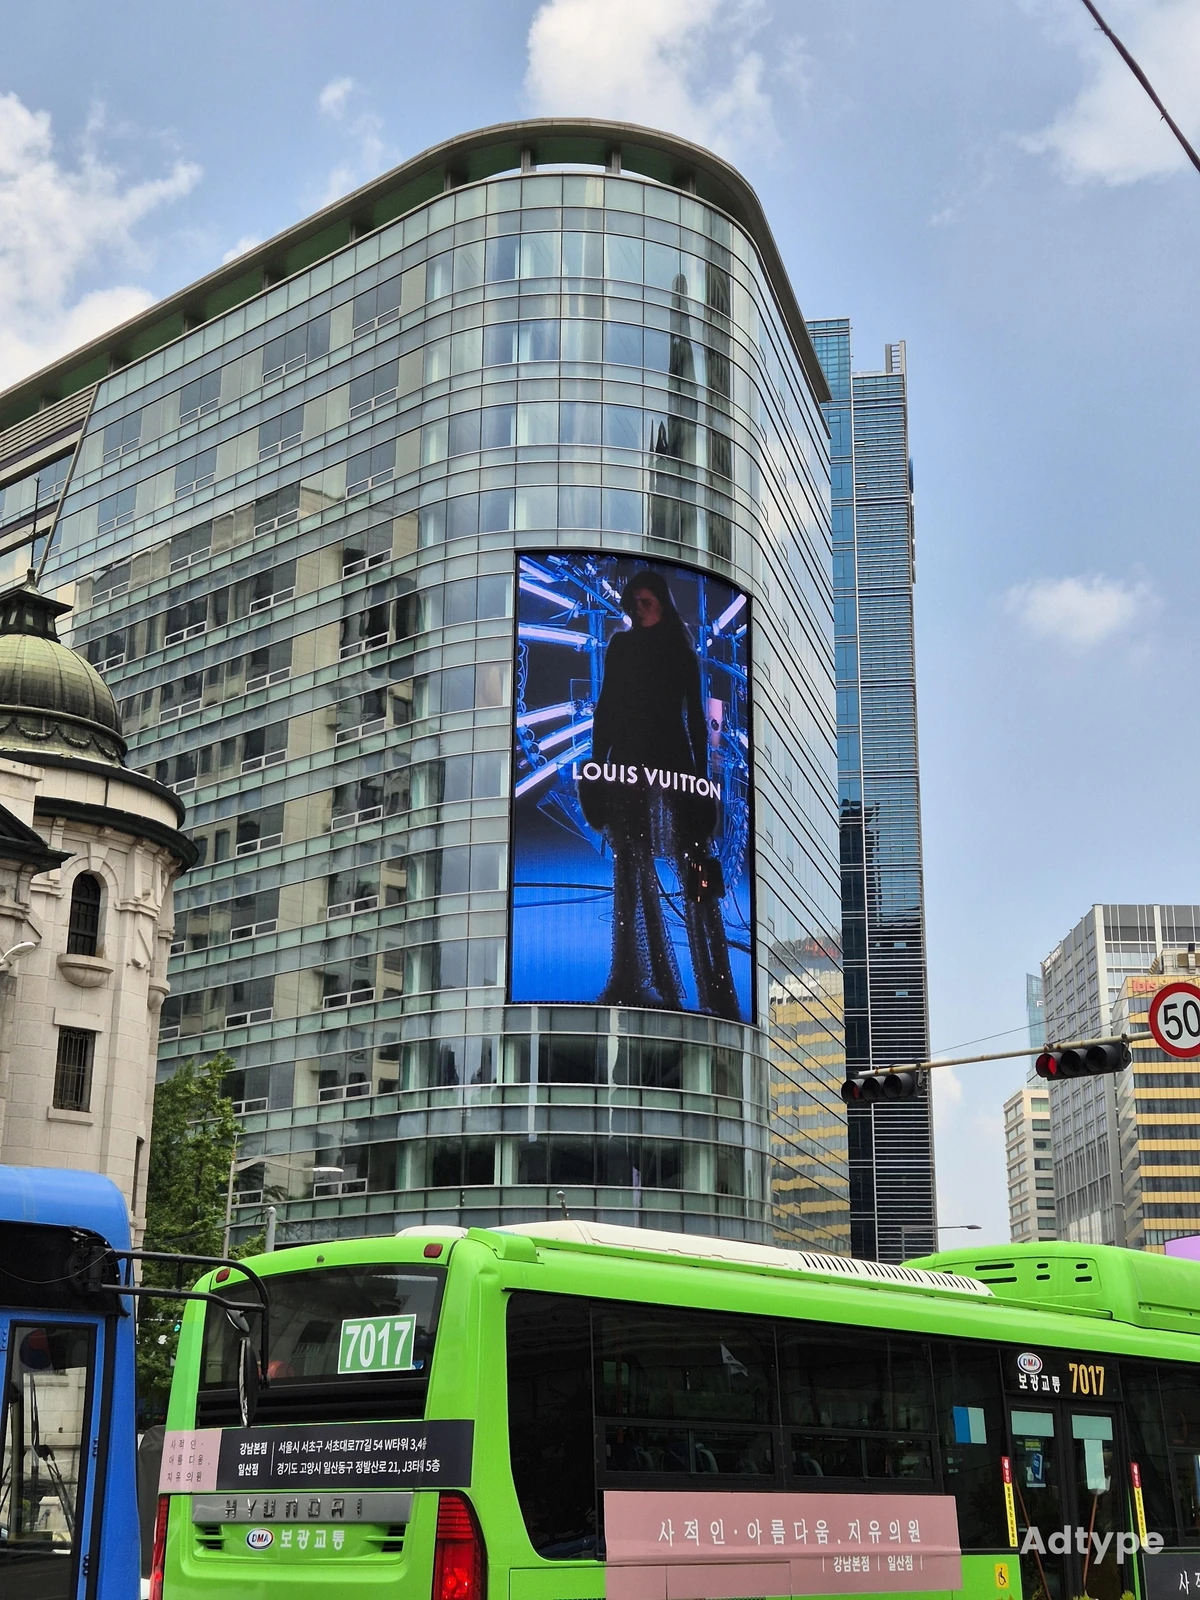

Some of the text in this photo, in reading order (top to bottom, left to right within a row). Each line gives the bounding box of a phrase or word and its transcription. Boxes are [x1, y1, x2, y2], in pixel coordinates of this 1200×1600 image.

[572, 761, 721, 801] LOUIS VUITTON
[1132, 979, 1156, 992] ibis
[1163, 1000, 1200, 1040] 50
[345, 1321, 411, 1369] 7017
[1018, 1373, 1060, 1393] 보광교통
[1069, 1362, 1105, 1396] 7017
[239, 1442, 268, 1455] 강남본점
[278, 1441, 300, 1454] 서울시
[301, 1440, 324, 1453] 서초구
[324, 1438, 372, 1453] 서초대로77길
[372, 1440, 383, 1451] 54
[384, 1437, 409, 1451] W타워
[237, 1463, 259, 1476] 일산점
[276, 1462, 298, 1475] 경기도
[299, 1461, 322, 1475] 고양시
[323, 1461, 354, 1475] 일산동구
[355, 1460, 387, 1474] 정발산로
[387, 1461, 401, 1475] 21,
[425, 1459, 440, 1473] 5층
[224, 1498, 363, 1519] HYUNDAI
[280, 1529, 345, 1550] 보광교통
[848, 1518, 921, 1544] 지유의원
[833, 1554, 913, 1573] 강남본점 일산점
